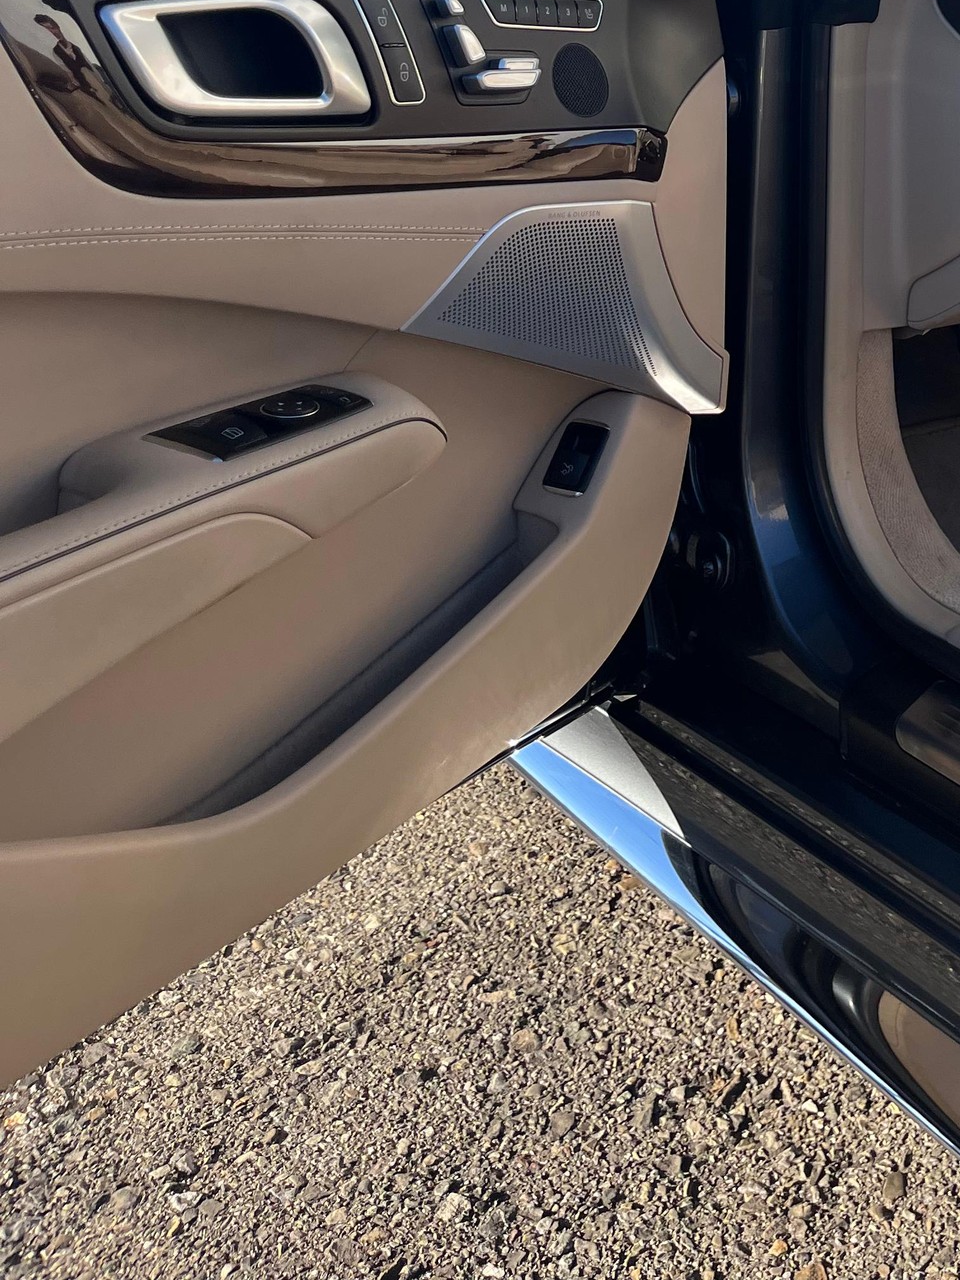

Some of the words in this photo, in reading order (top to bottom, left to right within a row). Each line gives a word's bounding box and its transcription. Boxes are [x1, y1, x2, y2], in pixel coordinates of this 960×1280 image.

[500, 4, 508, 12] M
[545, 6, 550, 15] 2
[565, 8, 571, 16] 3
[547, 211, 565, 219] BANG
[573, 210, 601, 218] OLUFSEN
